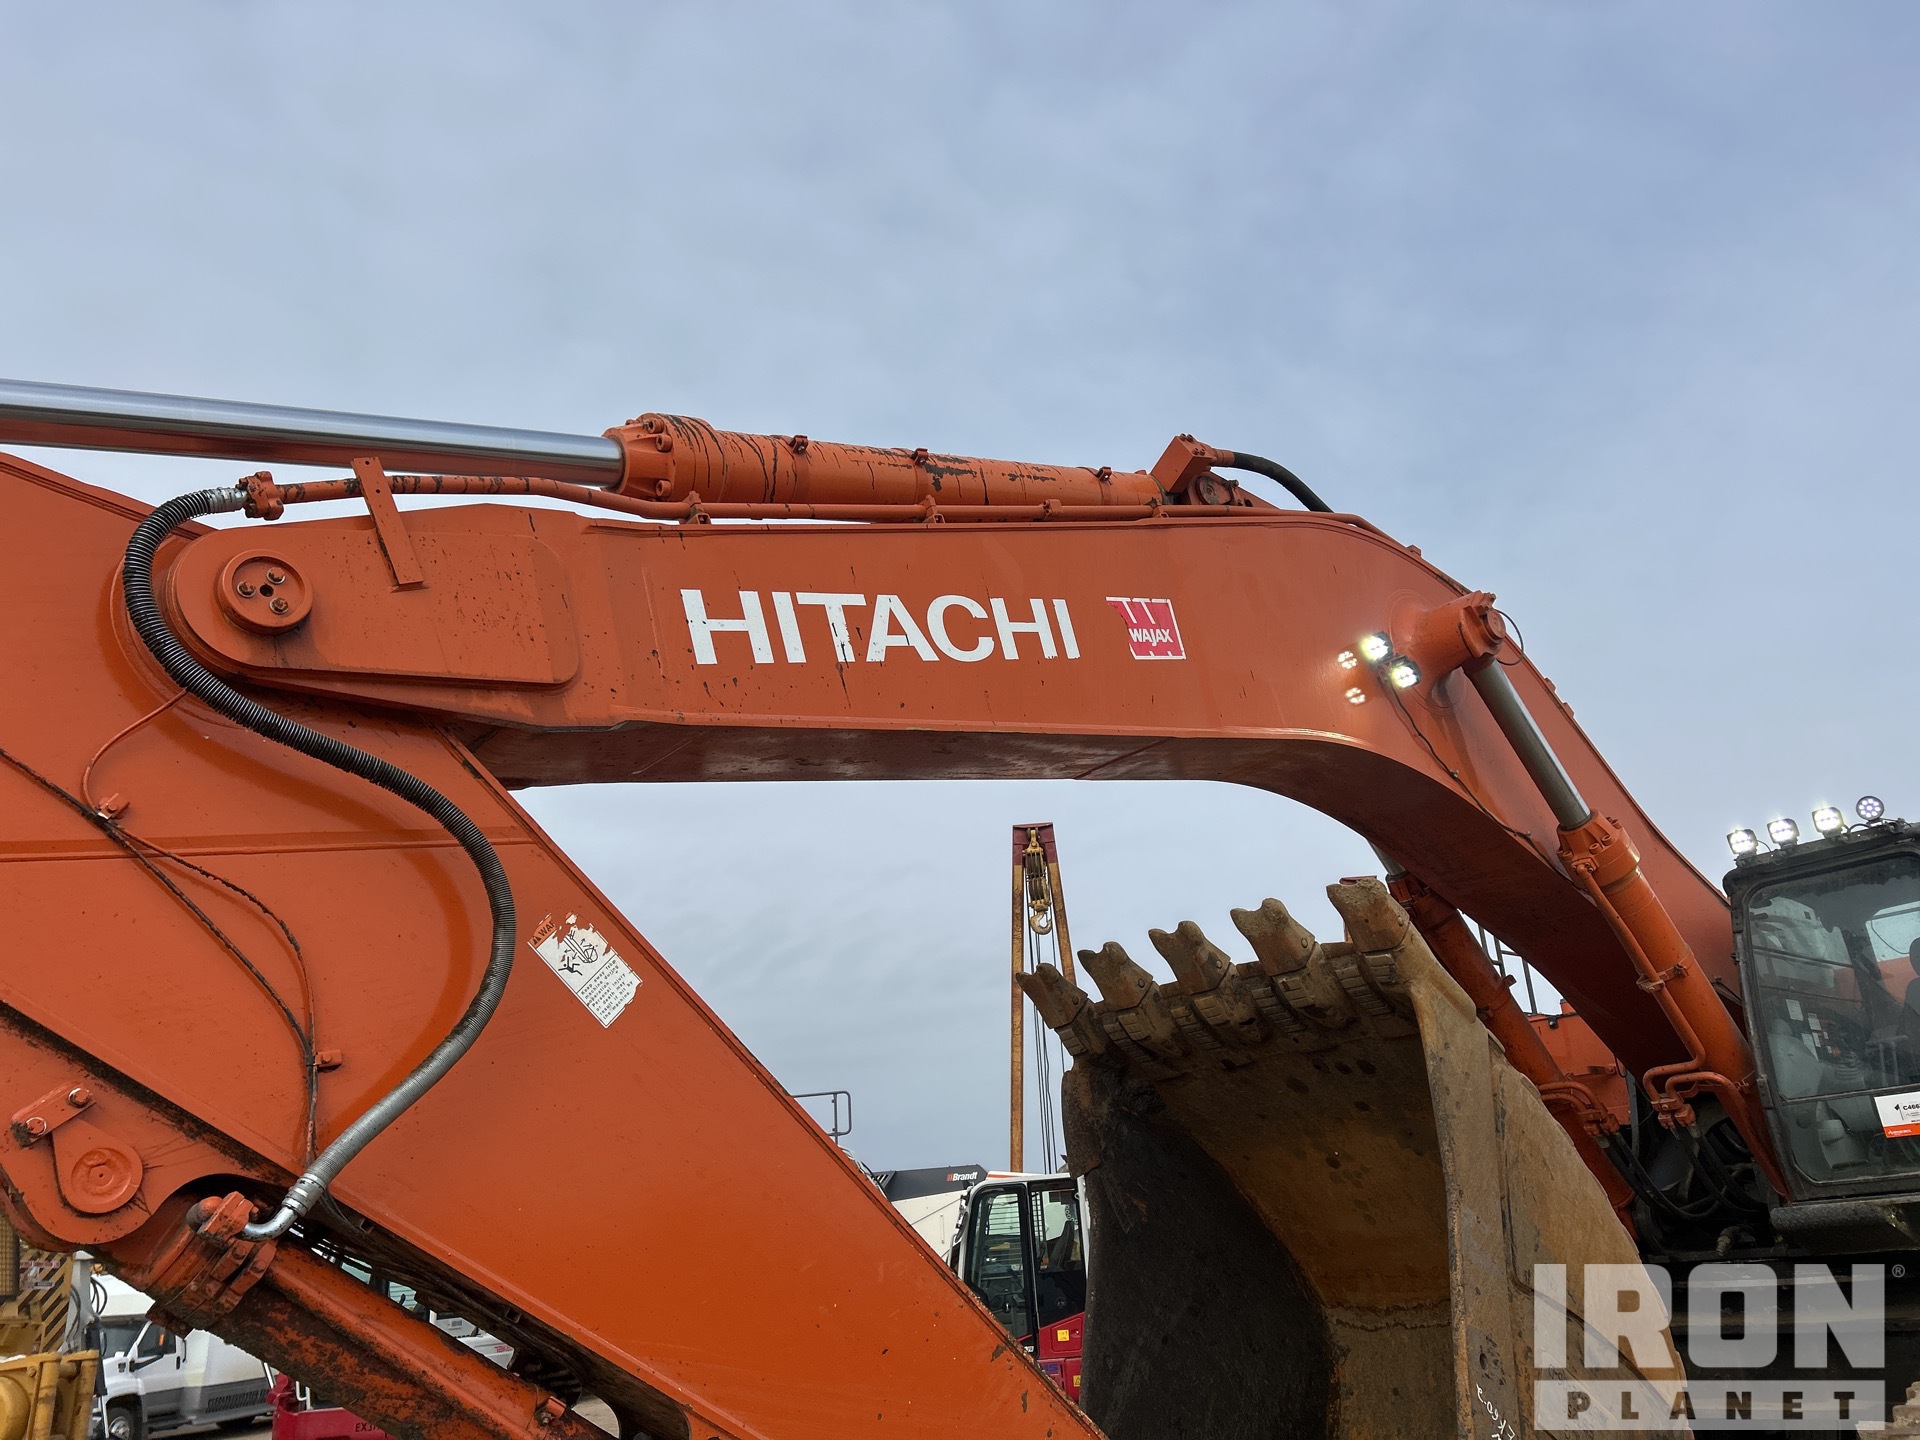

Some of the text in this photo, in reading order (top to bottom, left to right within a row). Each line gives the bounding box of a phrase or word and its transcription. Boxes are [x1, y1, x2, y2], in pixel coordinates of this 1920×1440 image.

[680, 588, 1081, 665] HITACHI
[1128, 628, 1174, 646] WAJAX
[594, 971, 605, 983] away
[612, 973, 626, 987] injury
[585, 981, 603, 999] machine
[602, 991, 615, 1005] death
[599, 1001, 613, 1016] result
[603, 1011, 611, 1020] the
[952, 1171, 978, 1181] Brandt
